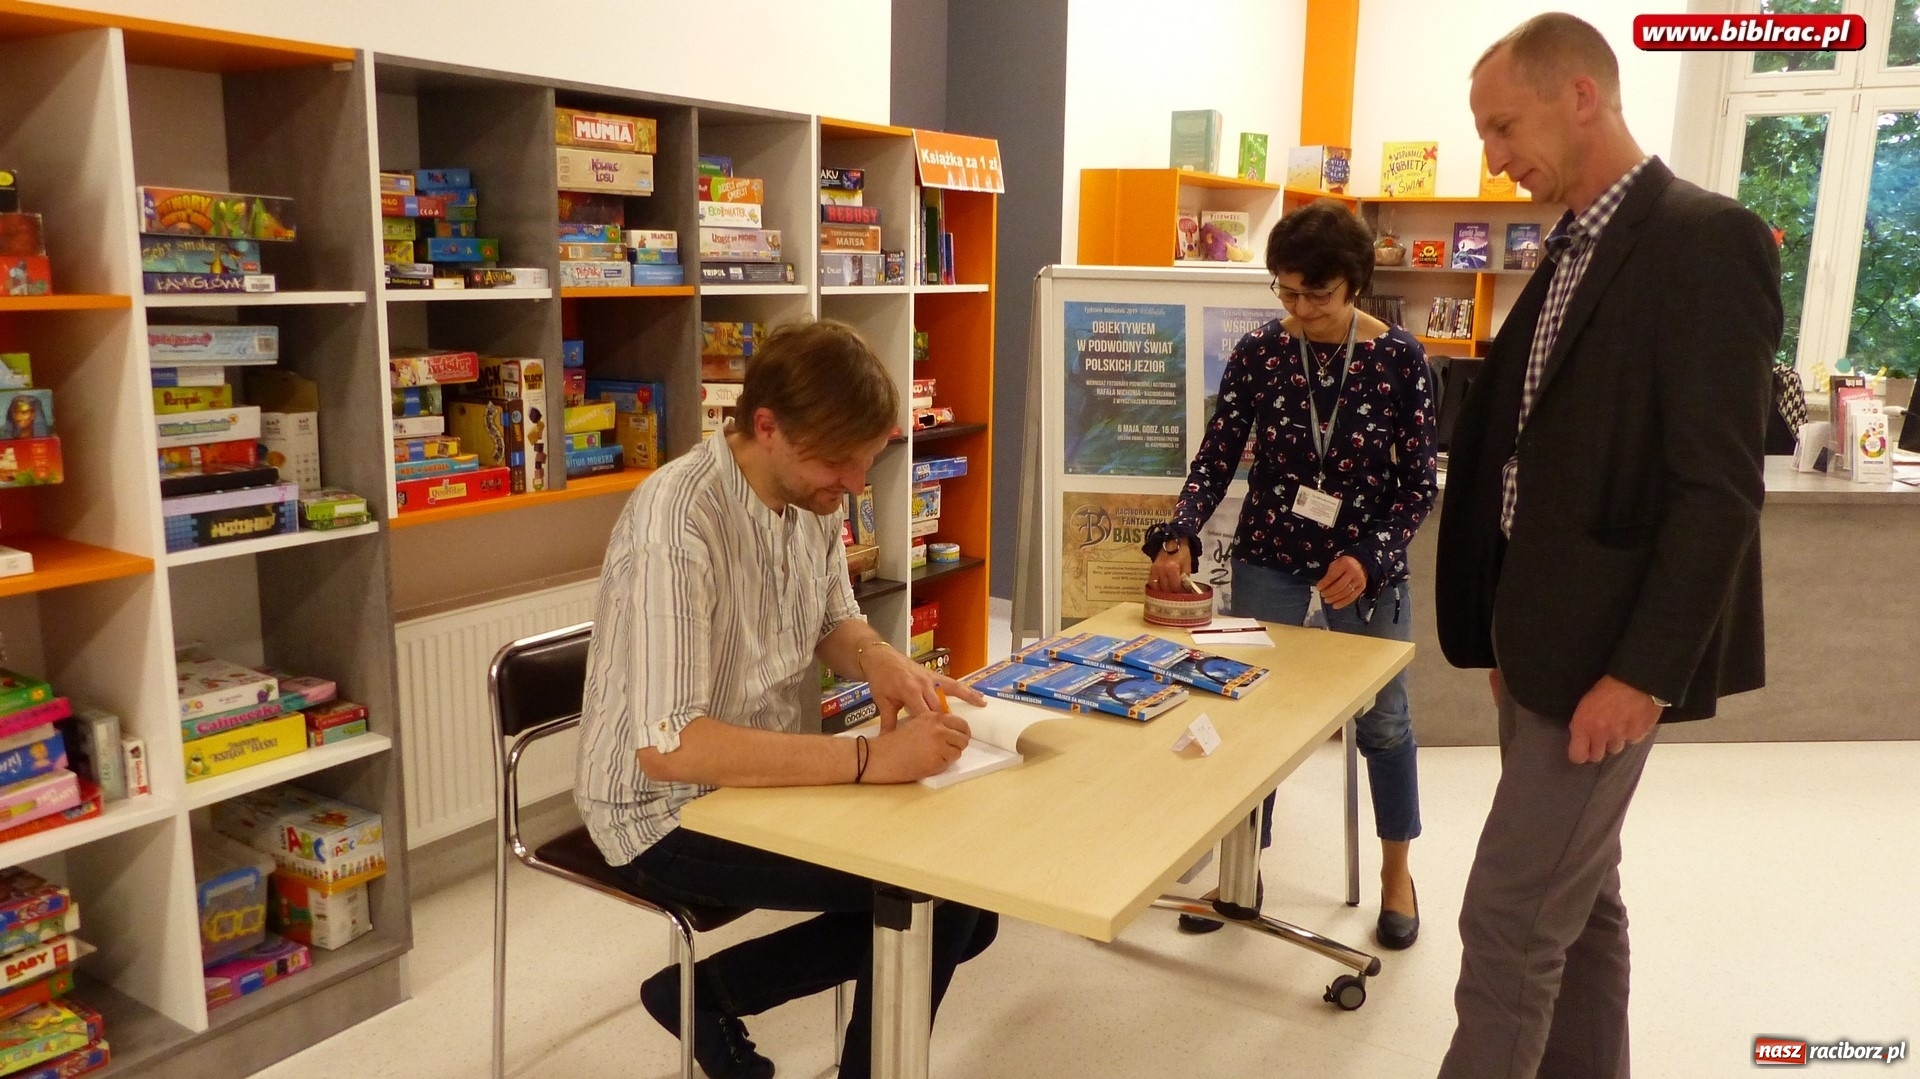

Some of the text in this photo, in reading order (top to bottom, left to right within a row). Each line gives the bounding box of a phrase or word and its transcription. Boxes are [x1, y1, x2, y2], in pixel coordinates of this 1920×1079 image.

[576, 120, 633, 143] MUMIA
[921, 148, 998, 171] Książka za 1 zł
[1389, 159, 1428, 176] KOBIETY
[827, 205, 879, 224] REBUSY
[835, 237, 866, 247] MARSA
[1092, 320, 1156, 335] OBIEKTYWEM
[1223, 318, 1260, 333] WŚRÓD
[1077, 339, 1174, 355] W PODWODNY ŚWIAT
[1085, 358, 1166, 373] POLSKICH JEZIOR
[524, 373, 543, 382] BLOCK
[1161, 425, 1180, 435] 16.00
[1083, 660, 1099, 668] MIEJSCE
[1105, 665, 1126, 674] MIEJSCEM
[1148, 666, 1166, 675] MIEJSCE
[1172, 672, 1194, 684] MIEJSCEM
[996, 692, 1014, 700] MIEJSCE
[1021, 696, 1042, 705] MIEJSCEM
[1053, 692, 1071, 701] MIEJSCE
[1077, 698, 1099, 708] MIEJSCEM
[846, 703, 876, 723] abalone
[286, 825, 326, 864] ABC
[5, 951, 48, 978] BABY
